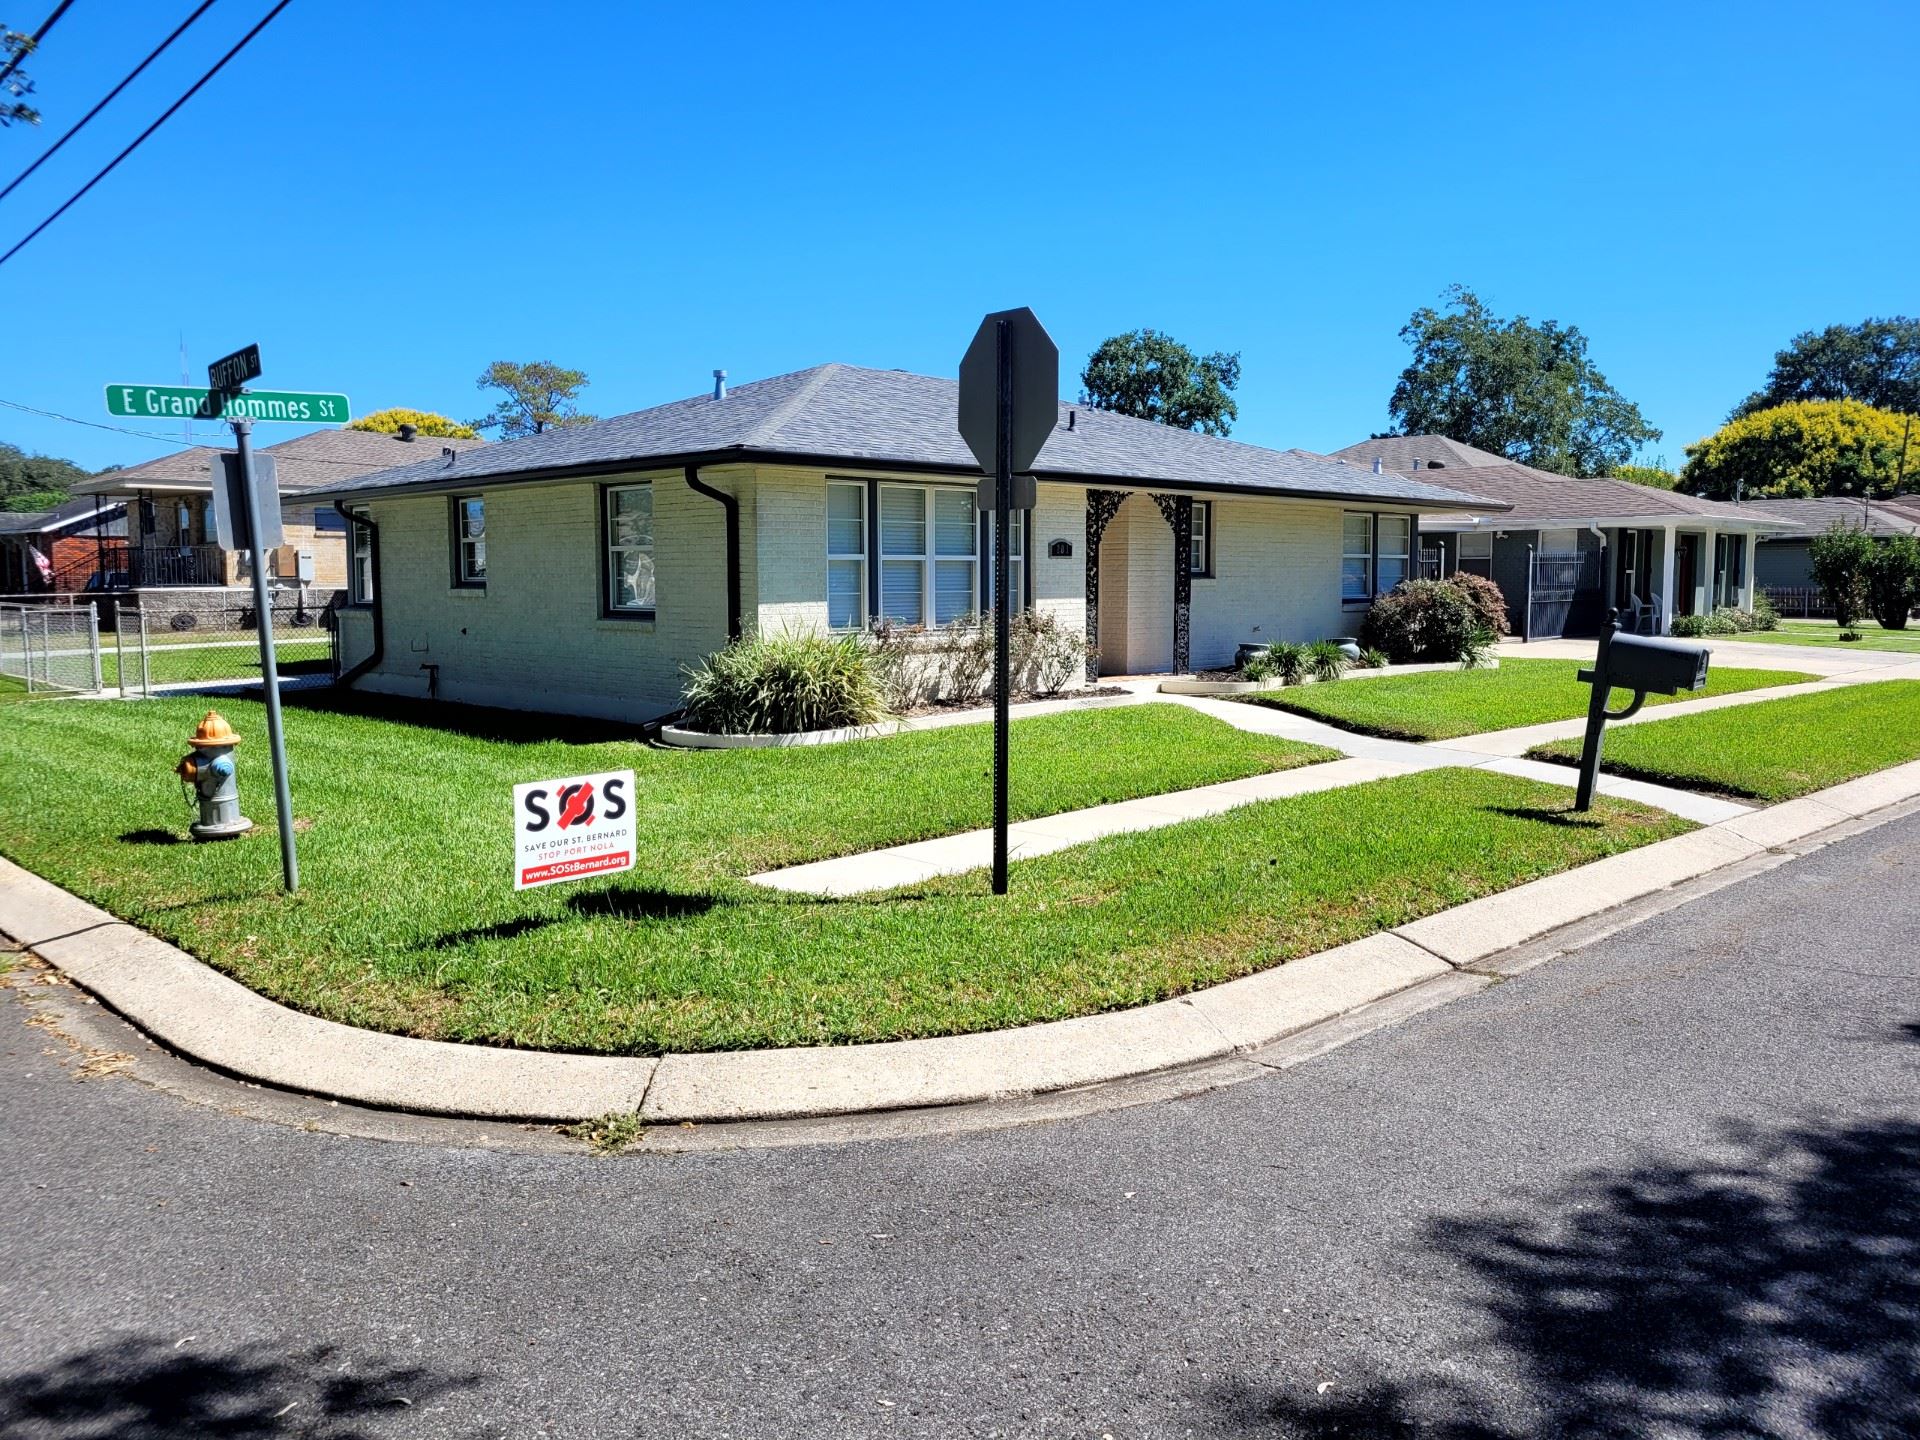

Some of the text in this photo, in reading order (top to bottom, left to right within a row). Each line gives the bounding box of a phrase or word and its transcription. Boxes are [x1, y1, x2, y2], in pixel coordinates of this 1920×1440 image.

[210, 353, 258, 389] BUFFON ST
[122, 389, 336, 419] E Grand Hommes St
[524, 778, 627, 832] SOS
[524, 828, 628, 853] SAVE OUR ST. BERNARD
[538, 842, 615, 861] STOP PORT NOLA
[525, 856, 626, 880] www.SOStBernard.org
